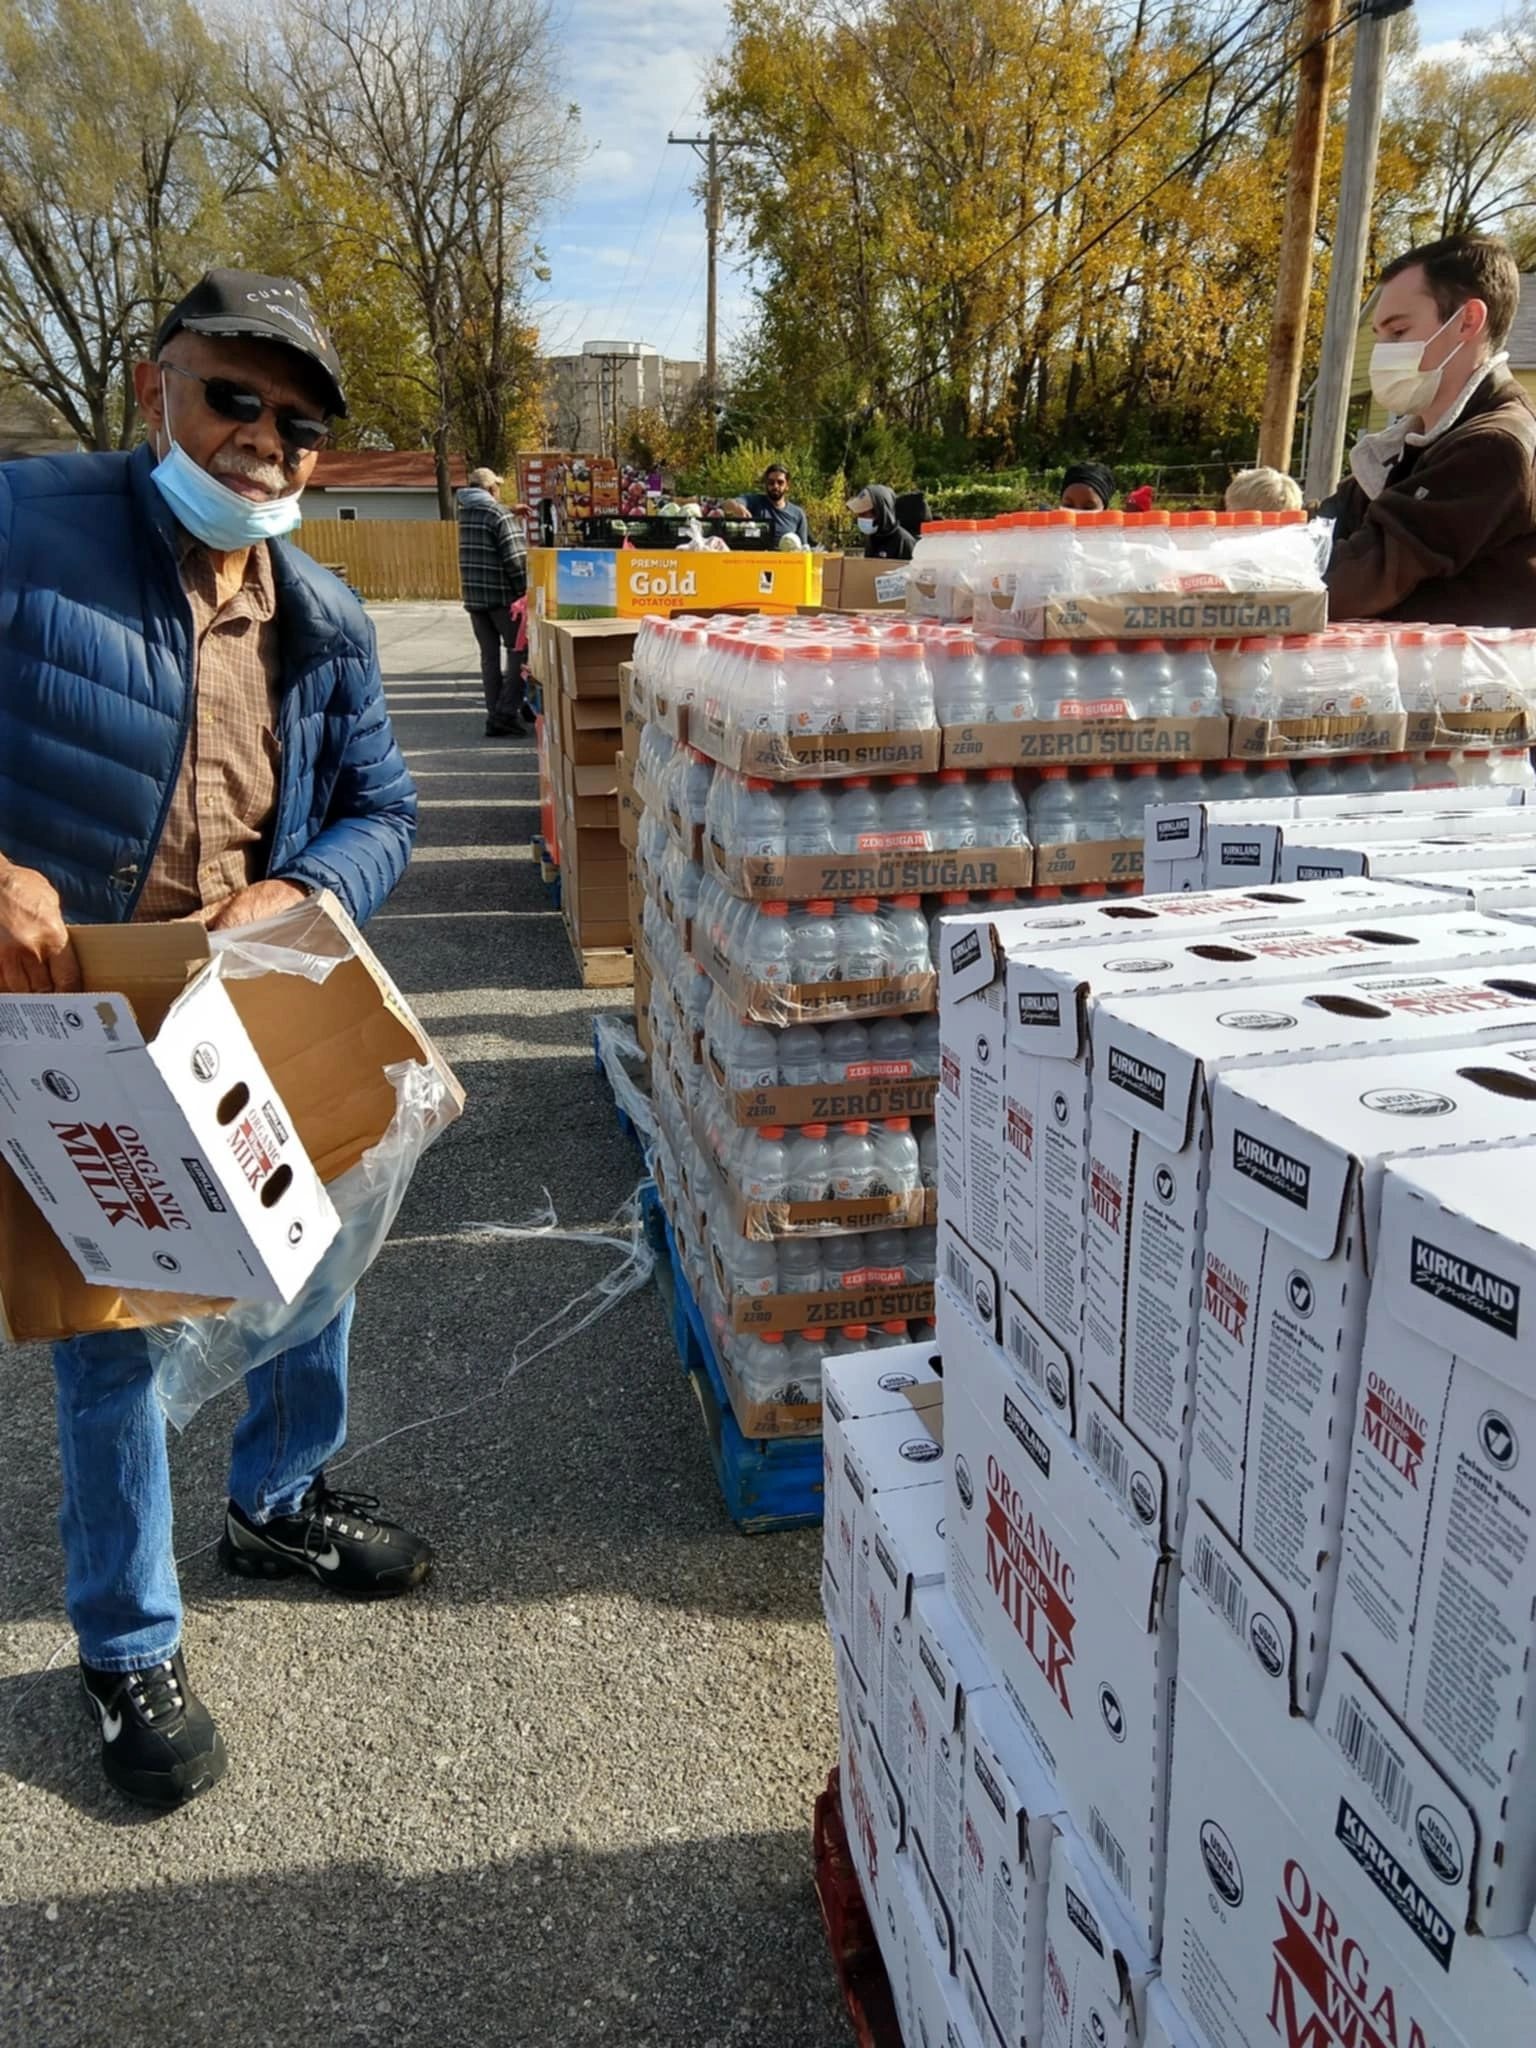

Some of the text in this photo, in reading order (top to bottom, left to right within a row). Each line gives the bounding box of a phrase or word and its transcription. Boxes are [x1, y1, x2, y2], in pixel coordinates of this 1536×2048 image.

[629, 570, 697, 595] Gold
[631, 559, 678, 568] PREMIUM
[632, 598, 684, 607] POTATOES
[1056, 612, 1088, 625] ZERO
[1124, 604, 1291, 629] ZERO SUGAR
[1086, 703, 1123, 715] SUGAR
[796, 744, 923, 764] ZERO SUGAR
[952, 742, 983, 755] ZERO
[1020, 730, 1192, 757] ZERO SUGAR
[885, 835, 924, 847] SUGAR
[1158, 820, 1188, 832] KIRKLAND
[1046, 860, 1076, 873] ZERO
[1111, 851, 1144, 873] ZE
[1223, 845, 1260, 856] KIRKLAND
[753, 875, 784, 887] ZERO
[821, 862, 998, 891] ZERO SUGAR
[1020, 995, 1058, 1011] KIRKLAND
[872, 1064, 908, 1074] SUGAR
[1111, 1050, 1165, 1092] KIRKLAND
[746, 1105, 776, 1117] ZERO
[812, 1090, 936, 1117] ZERO SUG
[248, 1108, 280, 1164] ORGANIC
[48, 1119, 144, 1230] MILK
[108, 1151, 147, 1203] Whole
[116, 1124, 192, 1231] ORGANIC
[226, 1127, 265, 1192] MILK
[1236, 1157, 1305, 1199] Signature
[1237, 1134, 1306, 1187] KIRKLAND
[1090, 1185, 1121, 1236] MILK
[868, 1271, 902, 1281] SUGAR
[1207, 1251, 1249, 1301] ORGANIC
[1417, 1244, 1515, 1310] KIRKLAND
[807, 1292, 935, 1323] ZERO SUG
[1204, 1284, 1246, 1347] MILK
[1415, 1269, 1512, 1325] Signature
[743, 1311, 772, 1323] ZERO
[1368, 1371, 1428, 1438] ORGANIC
[1381, 1403, 1410, 1441] Whole
[1006, 1400, 1049, 1463] KIRKLAND
[1361, 1407, 1422, 1491] MILK
[1457, 1464, 1499, 1504] Certified
[1459, 1452, 1531, 1517] Animal Welfare
[987, 1454, 1075, 1604] ORGANIC
[1006, 1522, 1048, 1609] Whole
[985, 1527, 1074, 1720] MILK
[1210, 1832, 1234, 1876] USDA
[1428, 1817, 1453, 1857] USDA
[1344, 1808, 1449, 1946] KIRKLAND
